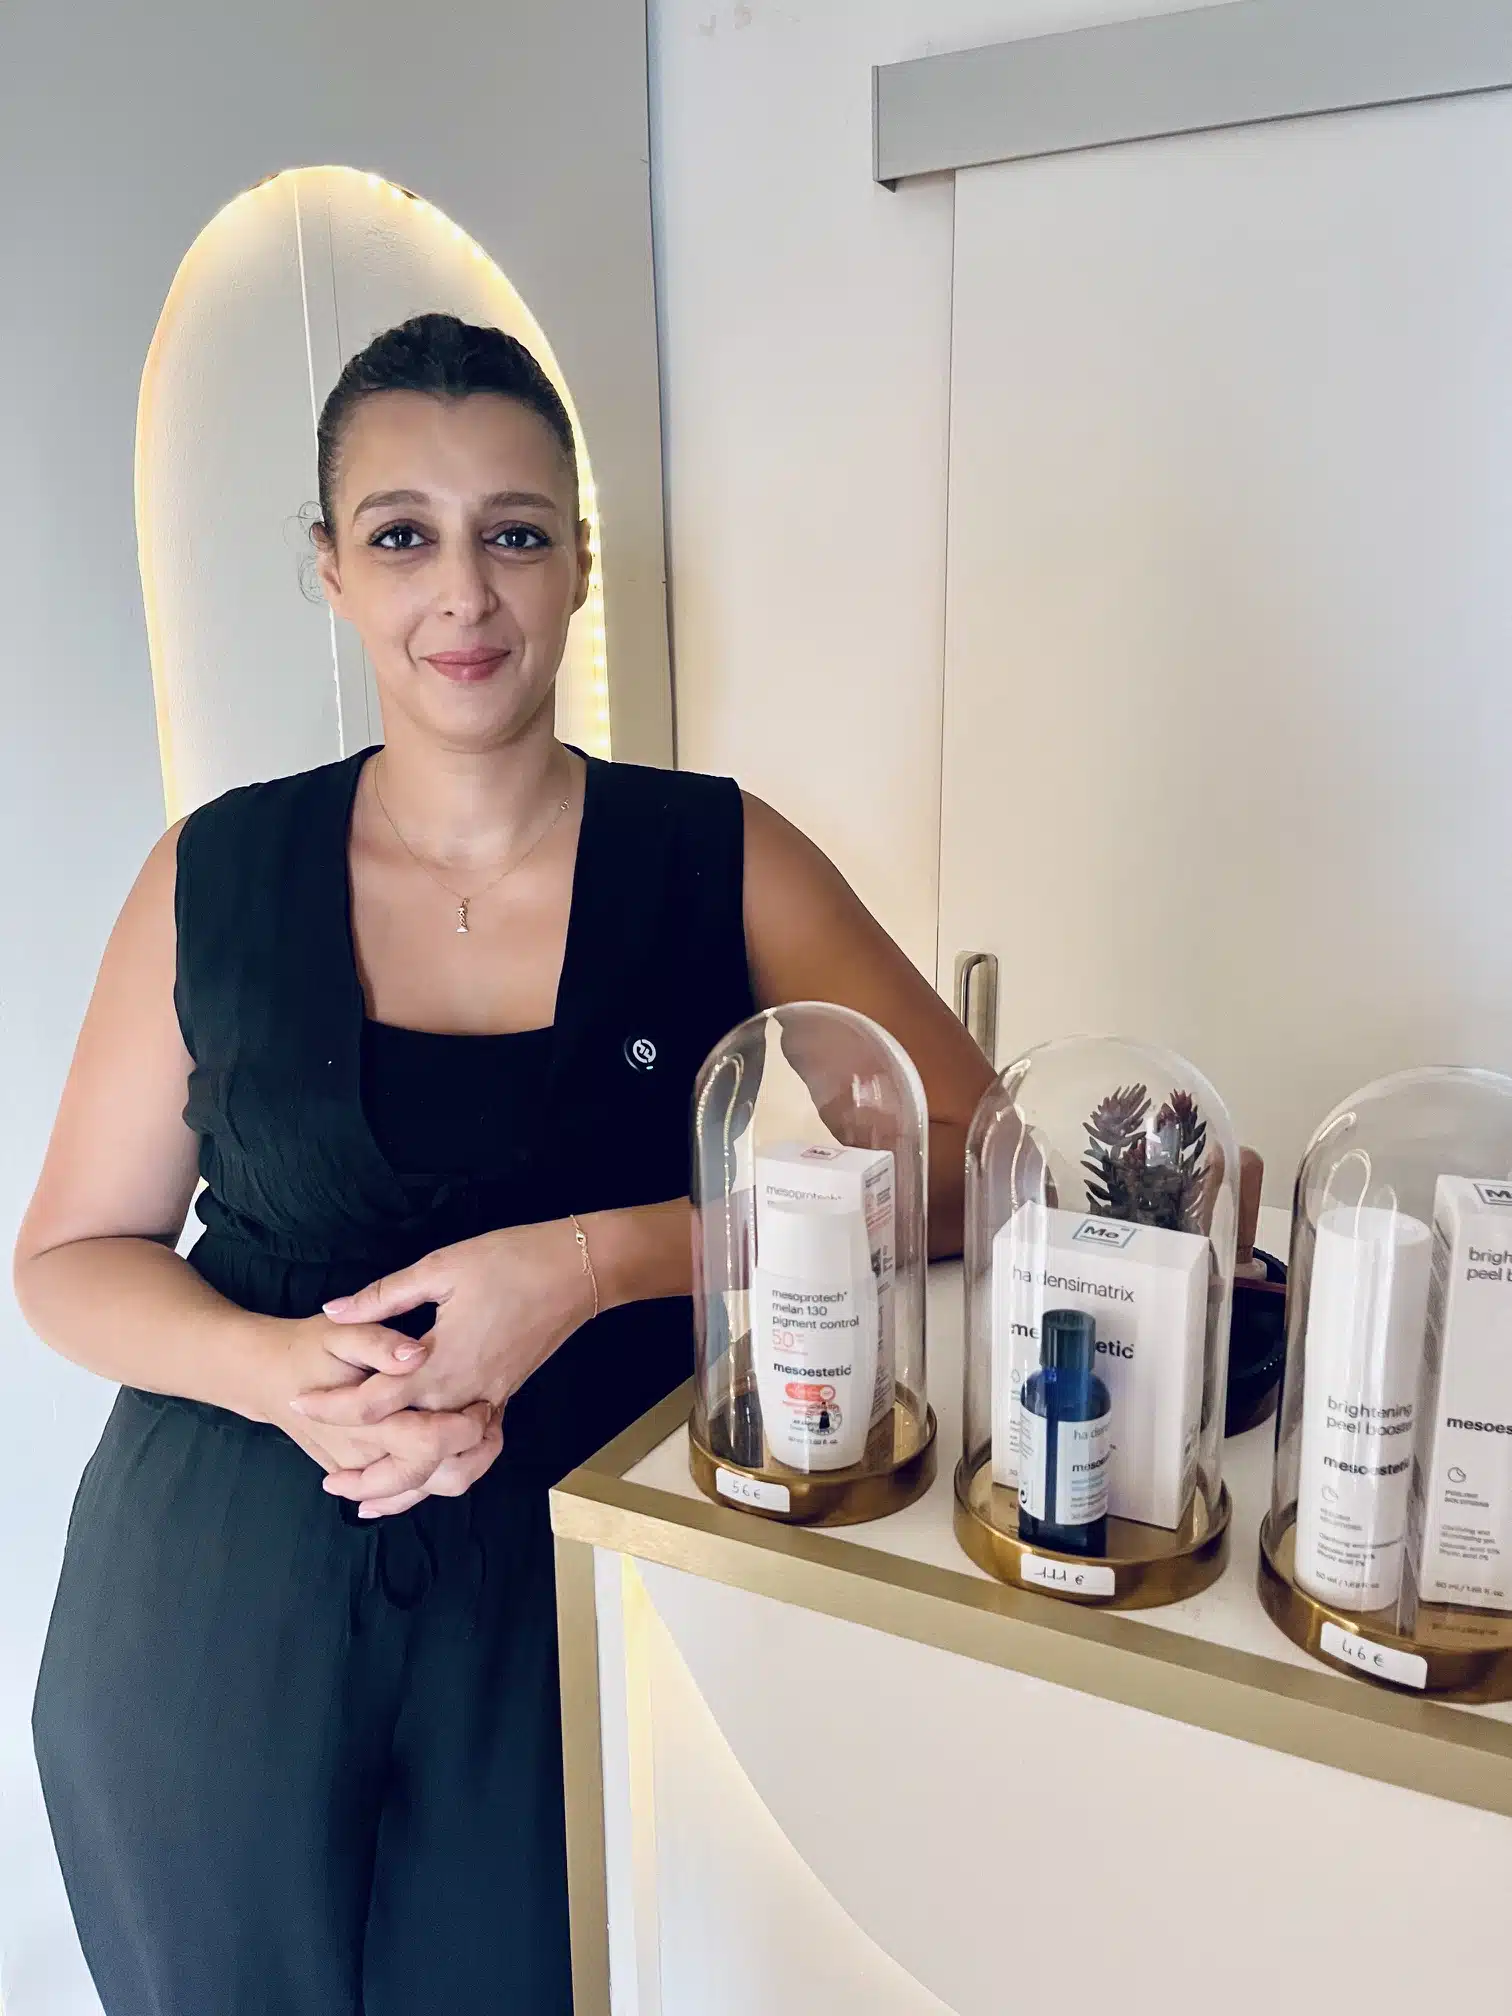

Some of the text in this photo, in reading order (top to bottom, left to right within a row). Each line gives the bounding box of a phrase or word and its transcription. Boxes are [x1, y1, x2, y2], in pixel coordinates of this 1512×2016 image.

[1084, 1226, 1119, 1239] Me
[1467, 1267, 1502, 1281] peel
[1013, 1264, 1135, 1303] ha densimatrix
[772, 1289, 844, 1303] mesoprotech
[772, 1302, 828, 1316] melan 130
[772, 1315, 859, 1329] pigment control
[1011, 1322, 1135, 1360] meetic
[773, 1362, 852, 1377] mesoestetic
[1327, 1395, 1413, 1418] brightening
[1325, 1416, 1360, 1434] peel
[1446, 1417, 1512, 1435] mesoes
